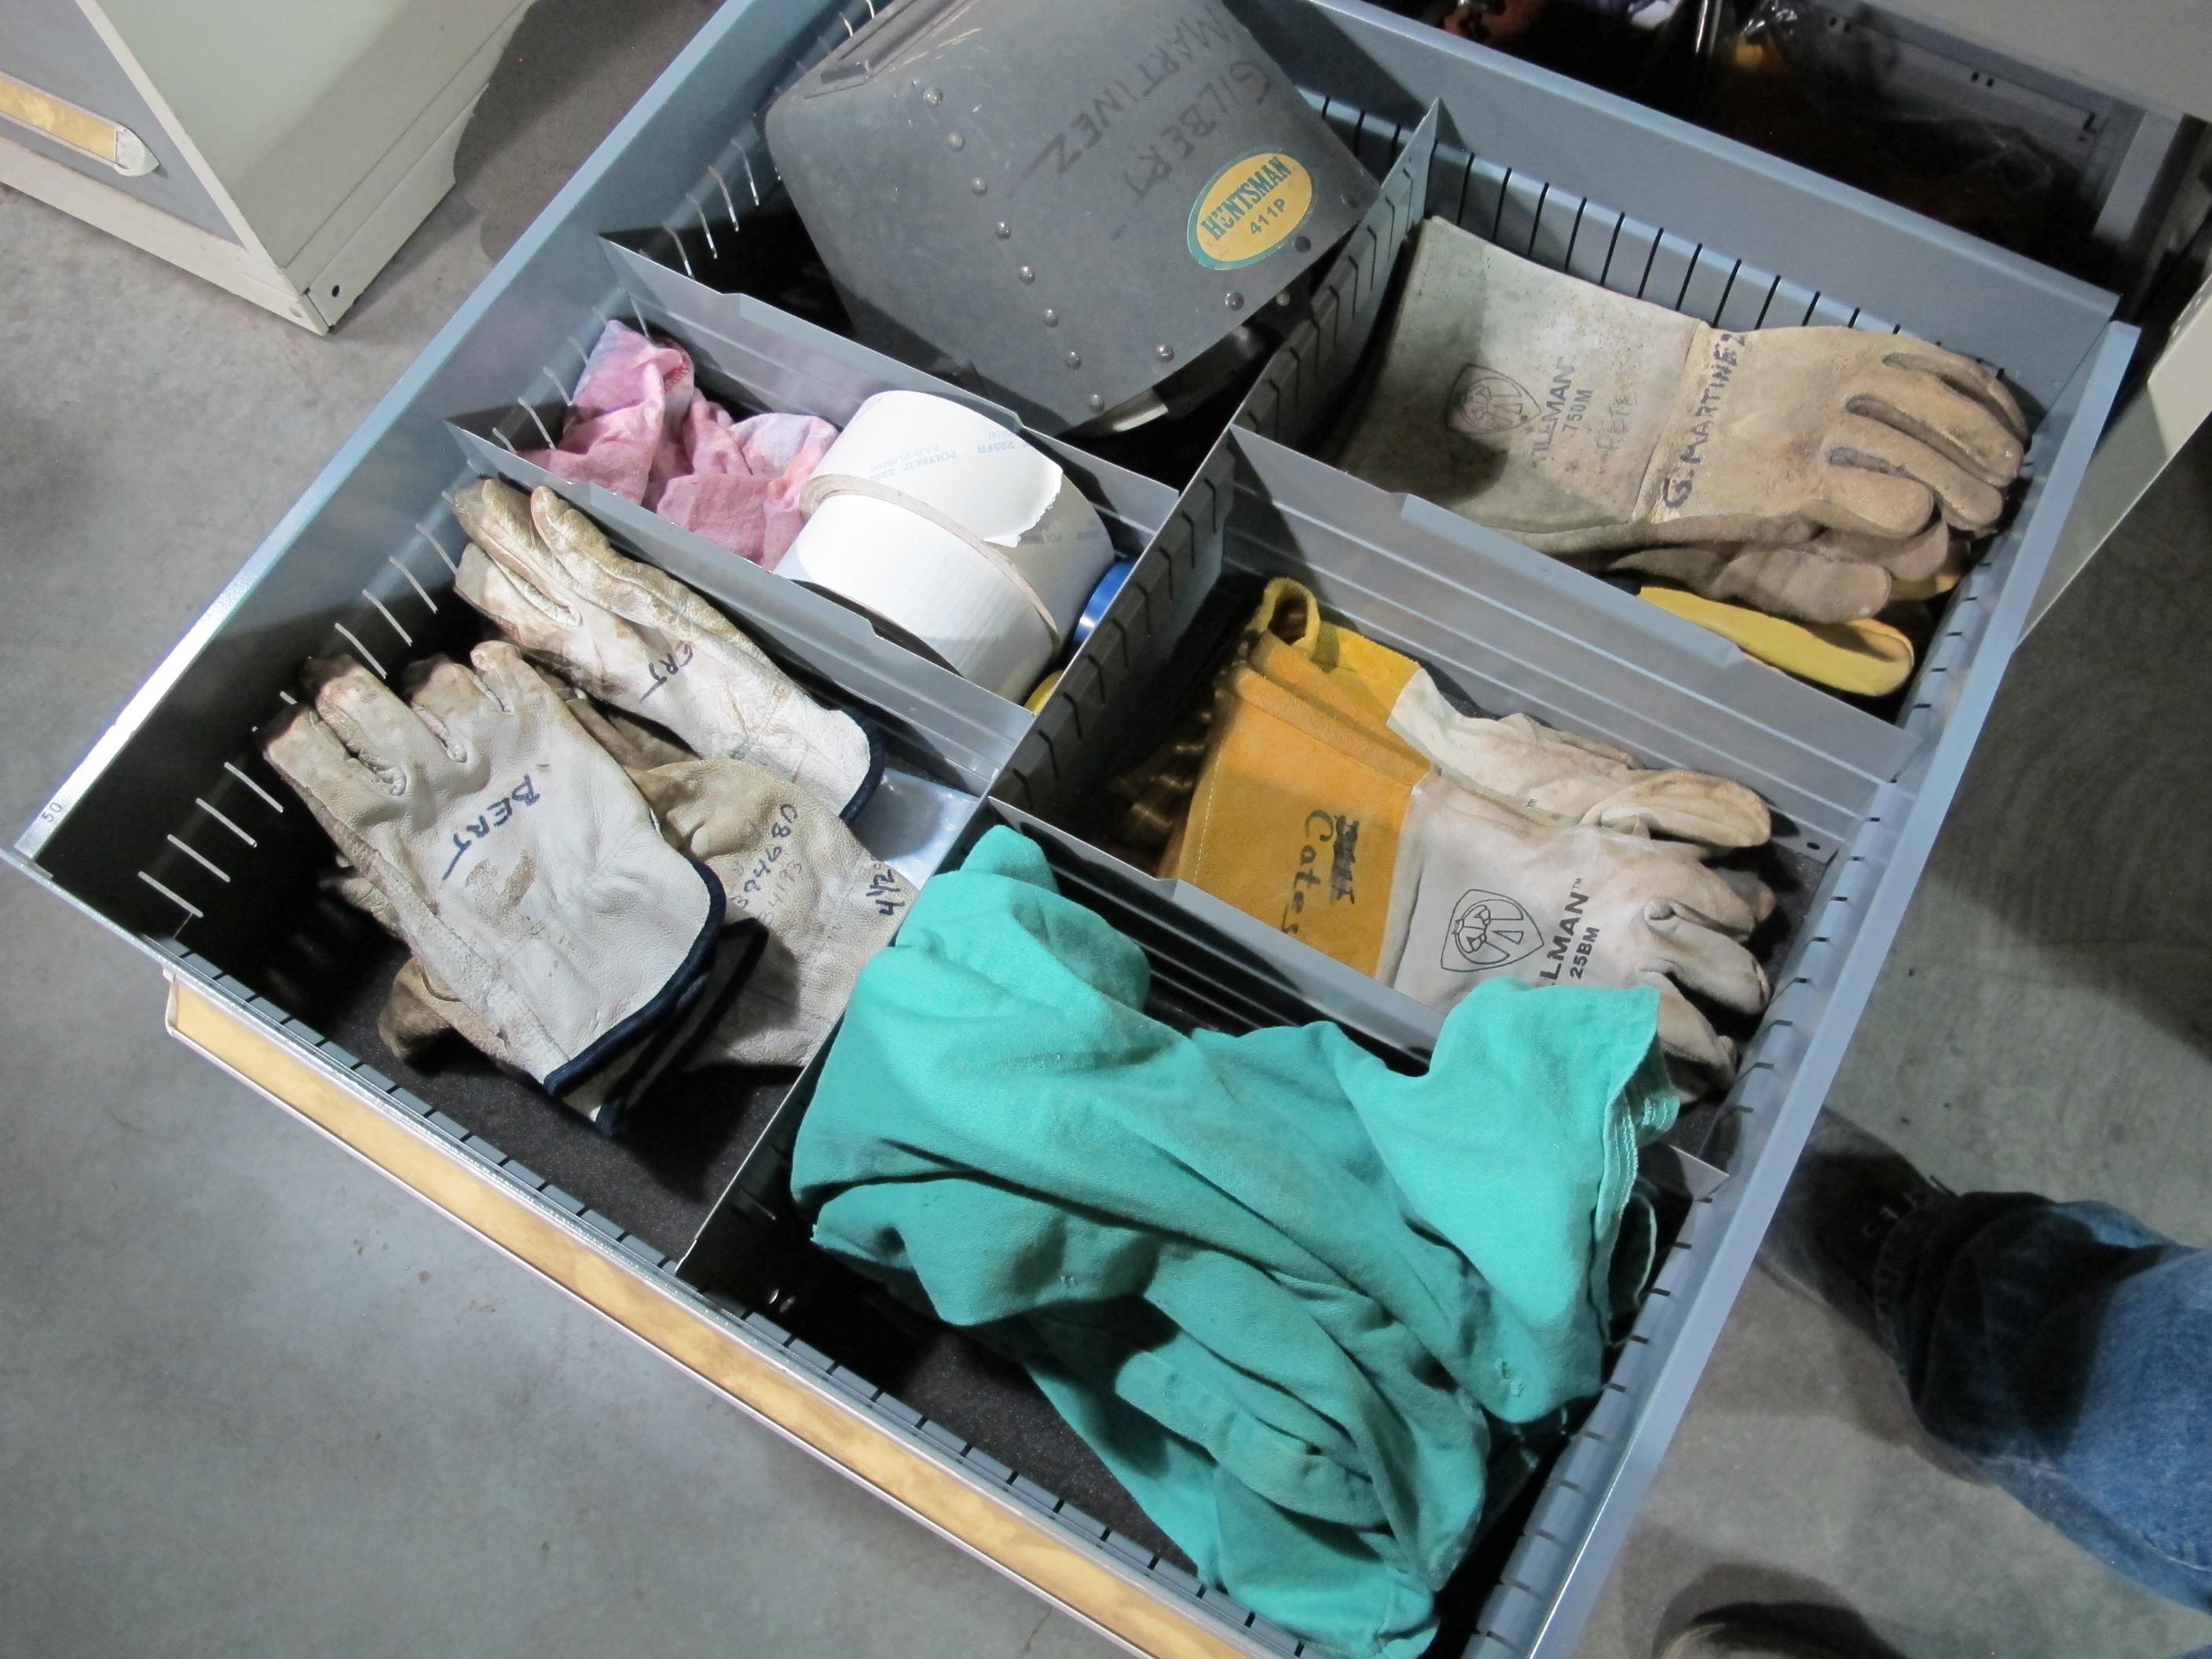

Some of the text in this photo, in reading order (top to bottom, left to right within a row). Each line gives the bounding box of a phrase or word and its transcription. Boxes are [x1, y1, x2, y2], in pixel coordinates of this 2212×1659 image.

[1018, 5, 1231, 179] MARTINEZ
[1119, 60, 1271, 212] GILBERT
[1250, 198, 1285, 235] 411P
[1562, 389, 1594, 432] 750M
[639, 639, 694, 705] ERT
[41, 802, 62, 822] 50
[441, 773, 540, 881] BERT
[1539, 889, 1590, 981] LMAN
[1569, 926, 1600, 980] 25BM
